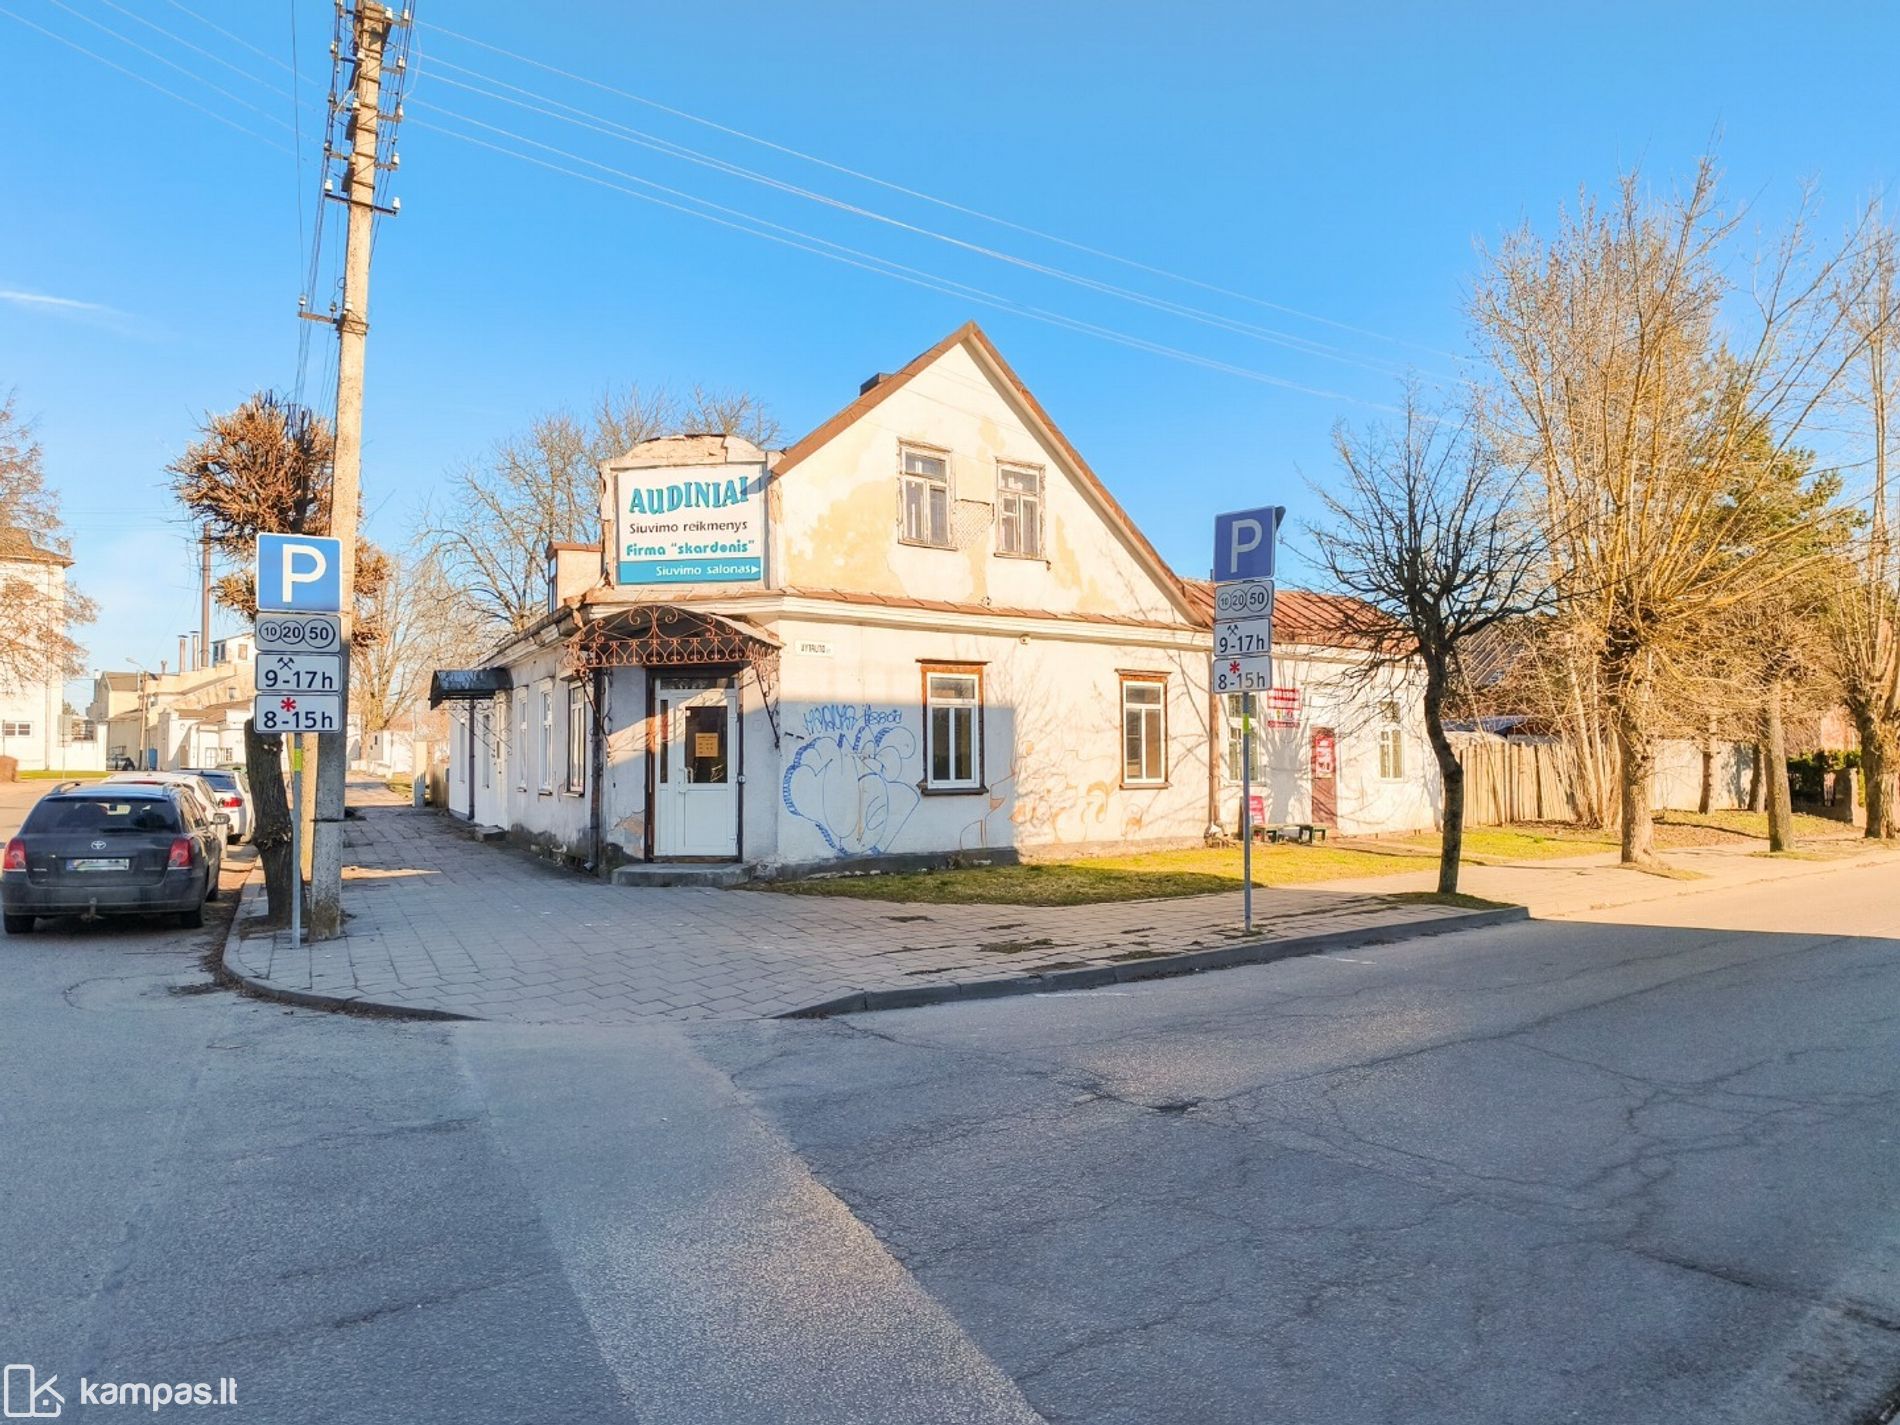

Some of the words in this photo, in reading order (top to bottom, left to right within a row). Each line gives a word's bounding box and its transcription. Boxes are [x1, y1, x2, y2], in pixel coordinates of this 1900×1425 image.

[629, 476, 749, 515] AUDINIAI
[629, 522, 678, 534] Siuvimo
[683, 520, 748, 534] reikmenys
[626, 542, 666, 556] Firma
[1230, 518, 1263, 573] P
[282, 543, 327, 603] P
[656, 565, 701, 577] Siuvimo
[706, 563, 750, 576] salonas
[1232, 594, 1243, 606] 20
[1253, 592, 1264, 605] 50
[264, 626, 277, 636] 10
[283, 625, 300, 639] 20
[309, 626, 329, 640] 50
